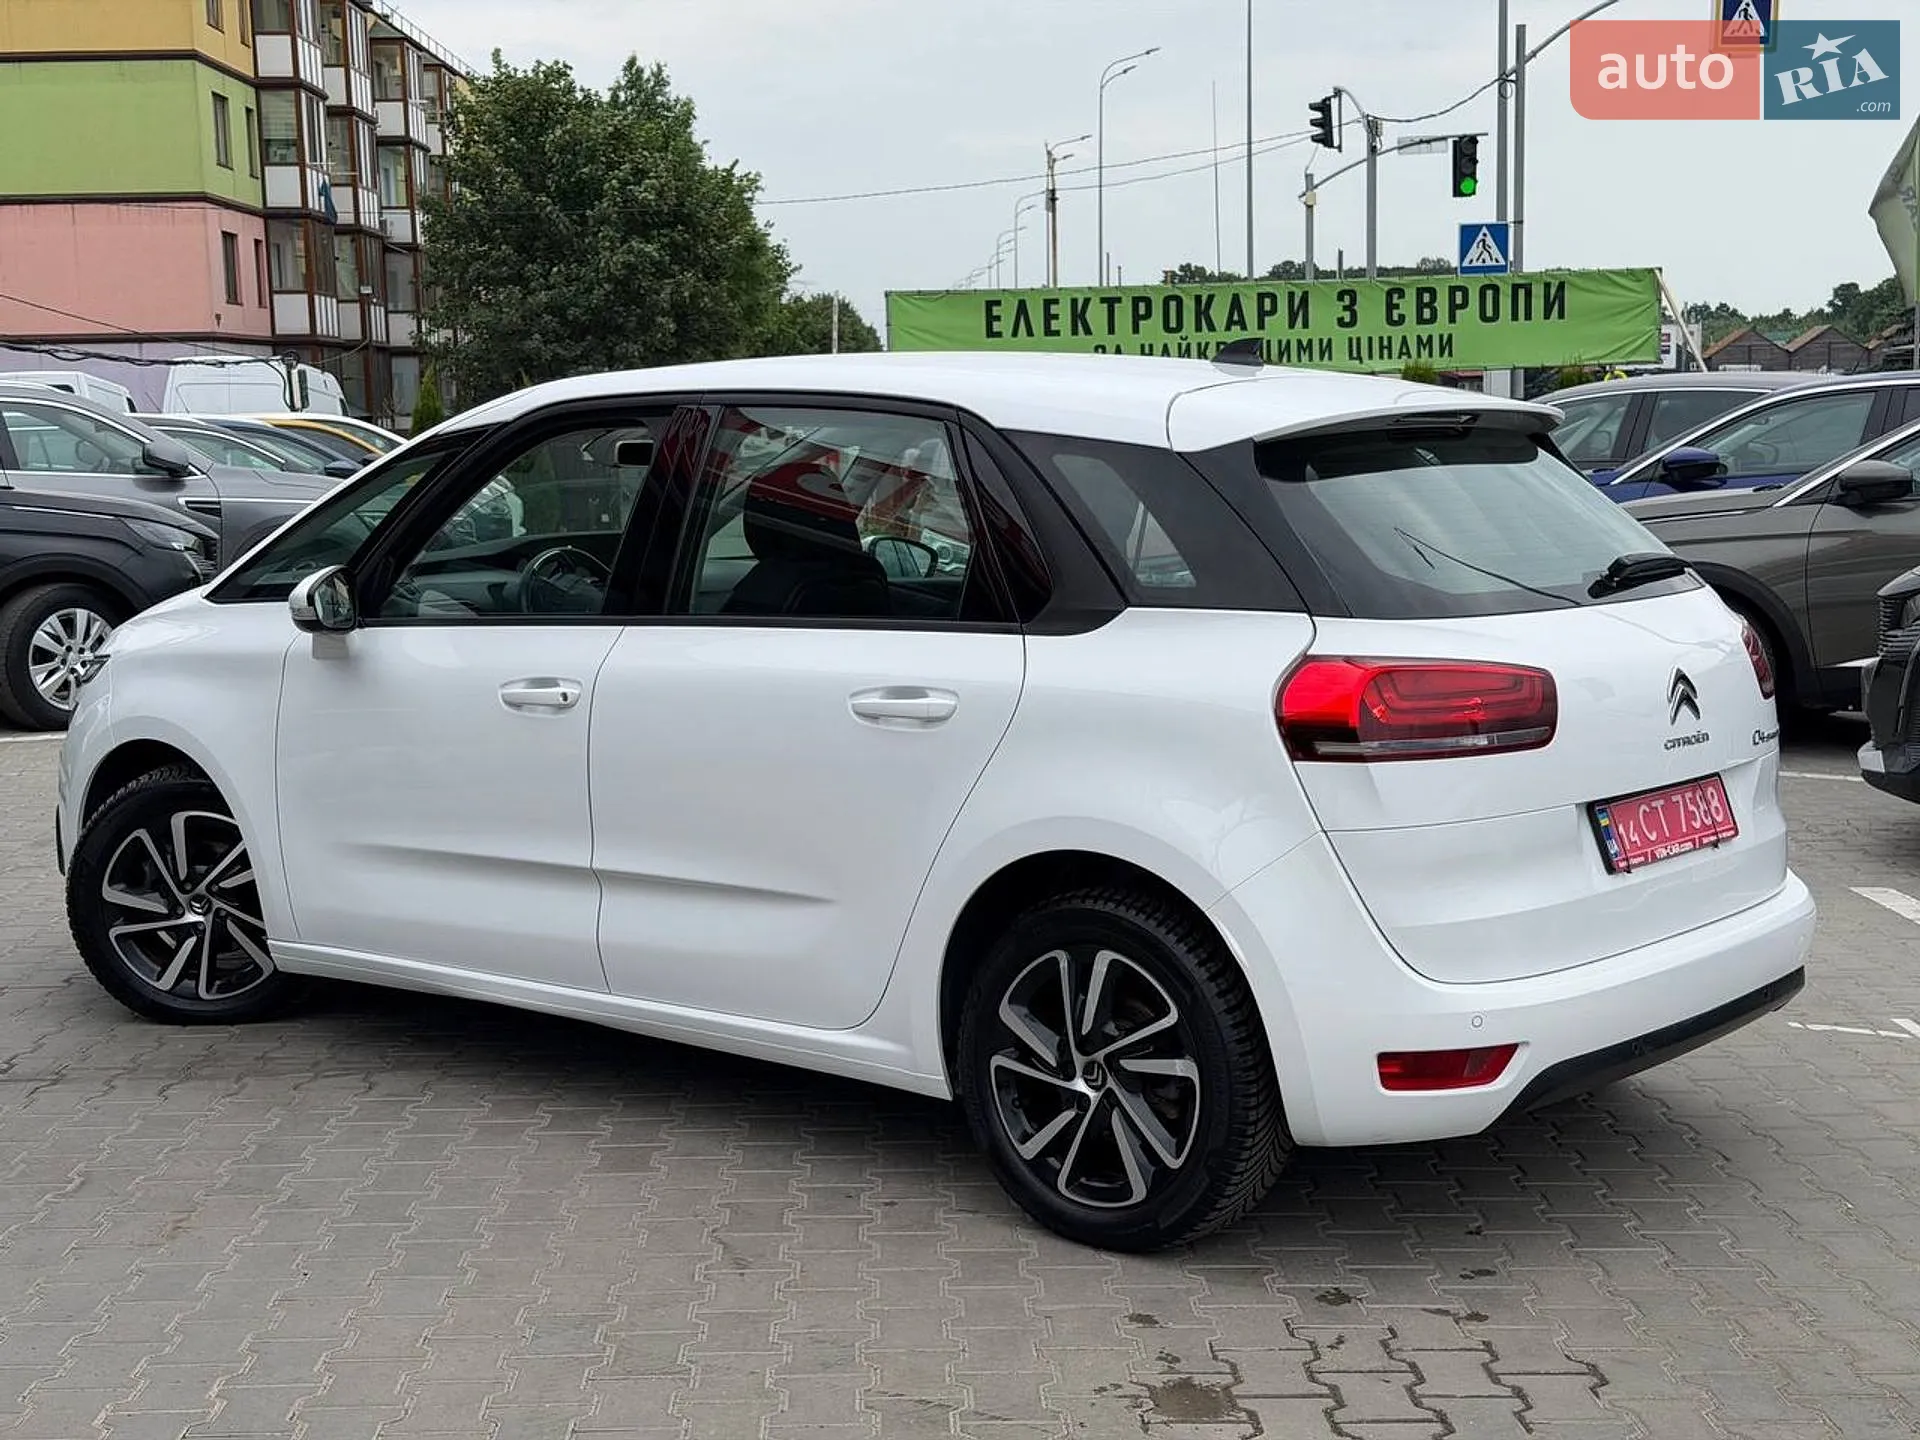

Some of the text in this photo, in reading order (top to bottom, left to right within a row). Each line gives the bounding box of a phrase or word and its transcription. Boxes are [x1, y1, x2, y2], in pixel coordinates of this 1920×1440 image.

[985, 280, 1566, 339] ЕЛЕКТРОКАРИ З ЄВРОПИ
[1347, 333, 1453, 364] ЦІНАМИ
